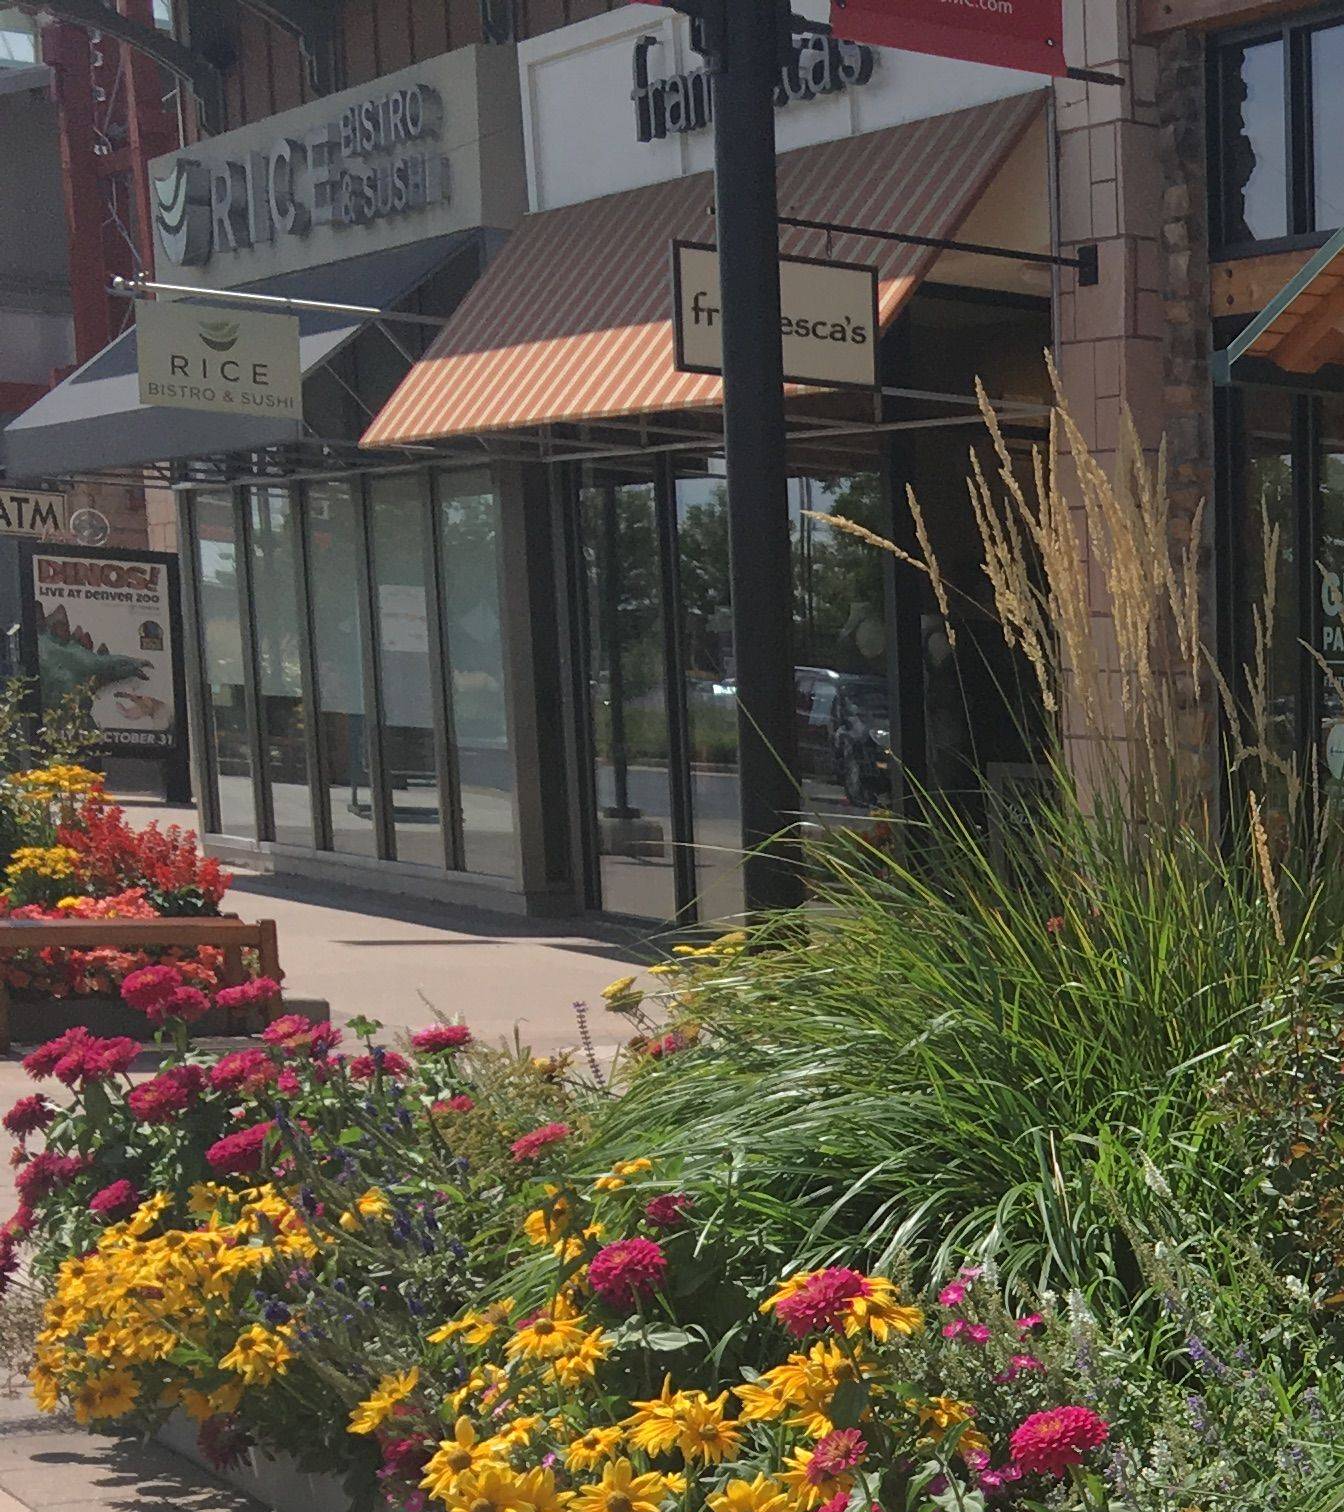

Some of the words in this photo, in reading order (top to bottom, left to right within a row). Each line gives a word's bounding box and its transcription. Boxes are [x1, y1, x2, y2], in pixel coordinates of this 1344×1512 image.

[211, 126, 336, 251] RICE
[340, 87, 428, 156] BISTRO
[362, 151, 440, 218] SUSHI
[691, 291, 867, 344] fresca's
[171, 355, 269, 385] RICE
[148, 382, 216, 401] BISTRO
[223, 390, 235, 403] &
[241, 392, 294, 409] SUSHI
[38, 558, 161, 592] DINOS!
[39, 586, 66, 598] LIVE
[67, 588, 82, 599] AT
[136, 593, 161, 604] ZOO
[102, 731, 156, 745] CTOBER
[159, 733, 173, 746] 31
